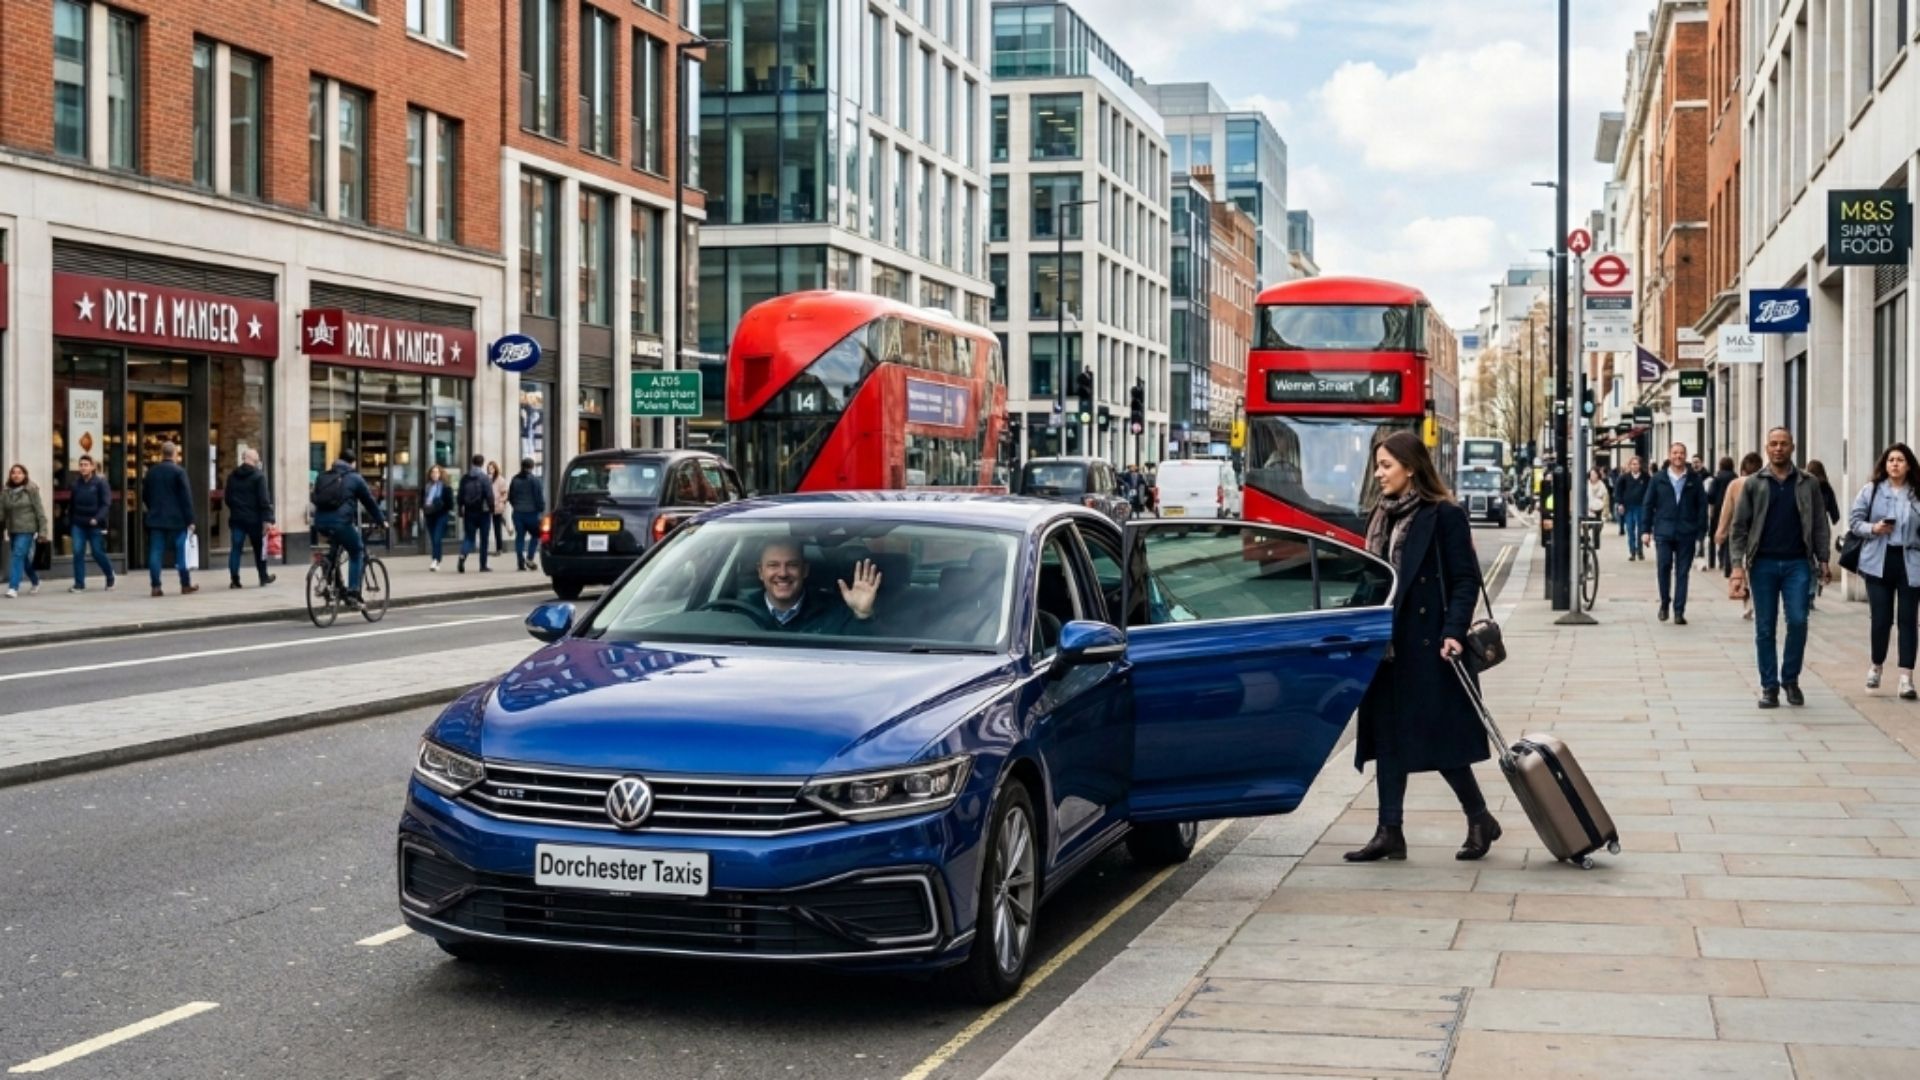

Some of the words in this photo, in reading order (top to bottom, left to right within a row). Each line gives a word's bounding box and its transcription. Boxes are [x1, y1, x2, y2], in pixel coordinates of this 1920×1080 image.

[1840, 200, 1895, 221] M&S
[1571, 232, 1586, 248] A
[1840, 238, 1895, 254] FOOD
[103, 287, 149, 333] PRET
[153, 294, 165, 336] A
[172, 297, 239, 344] MANGER
[382, 326, 392, 361] A
[396, 328, 445, 367] MANGER
[1368, 376, 1391, 397] 14
[797, 392, 815, 412] 14
[540, 852, 647, 881] Dorchester
[652, 860, 703, 885] Taxis
